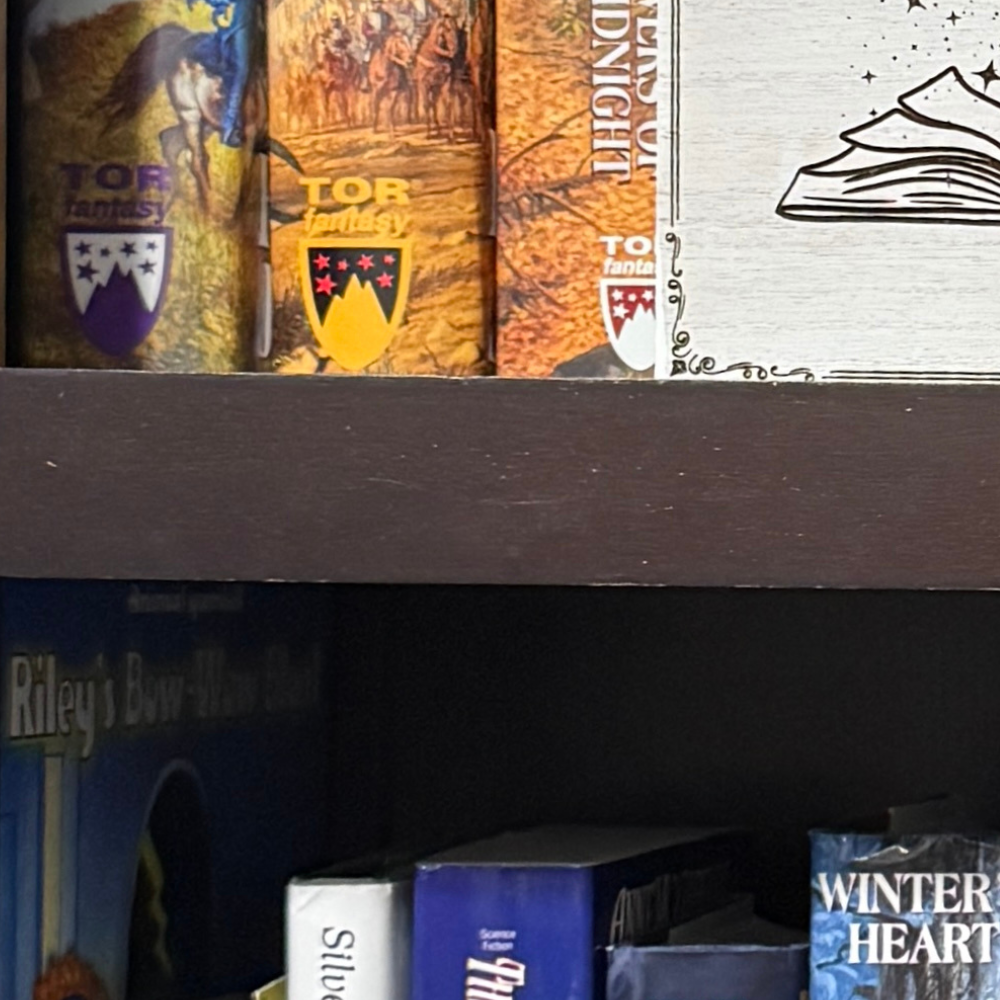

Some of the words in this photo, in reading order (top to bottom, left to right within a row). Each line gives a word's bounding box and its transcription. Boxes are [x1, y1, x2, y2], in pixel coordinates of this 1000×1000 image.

[60, 163, 172, 192] TOR
[299, 176, 411, 206] TOR
[304, 206, 412, 238] fantasy
[9, 650, 117, 758] Riley's
